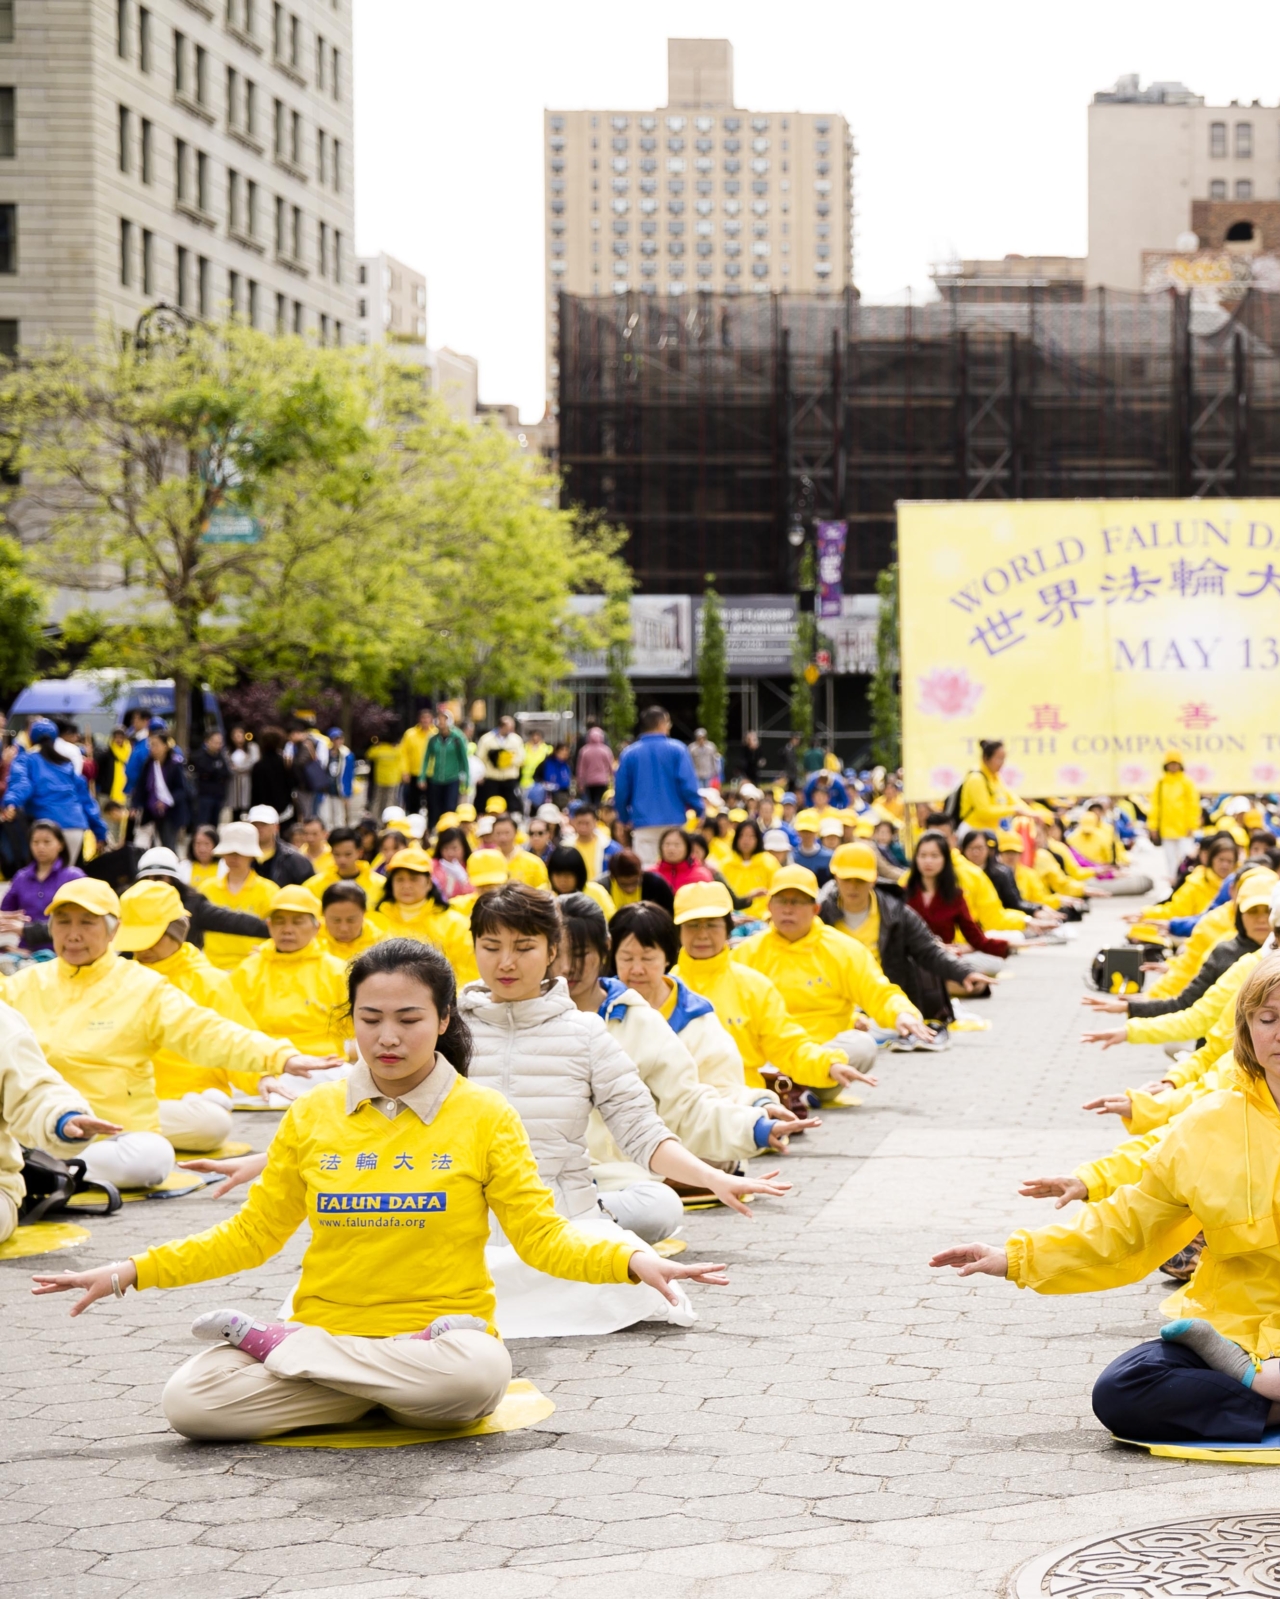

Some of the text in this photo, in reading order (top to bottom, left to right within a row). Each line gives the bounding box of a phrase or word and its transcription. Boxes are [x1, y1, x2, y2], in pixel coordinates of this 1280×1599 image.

[950, 536, 1087, 616] WORLD
[1101, 519, 1234, 555] FALUN
[1113, 638, 1223, 672] MAY
[1027, 703, 1068, 731] 真
[1176, 702, 1218, 730] 善
[1072, 733, 1246, 754] COMPASSION
[320, 1152, 453, 1171] 法輪大法
[320, 1195, 441, 1210] FALUN DAFA
[319, 1217, 426, 1229] www.falundafa.org
